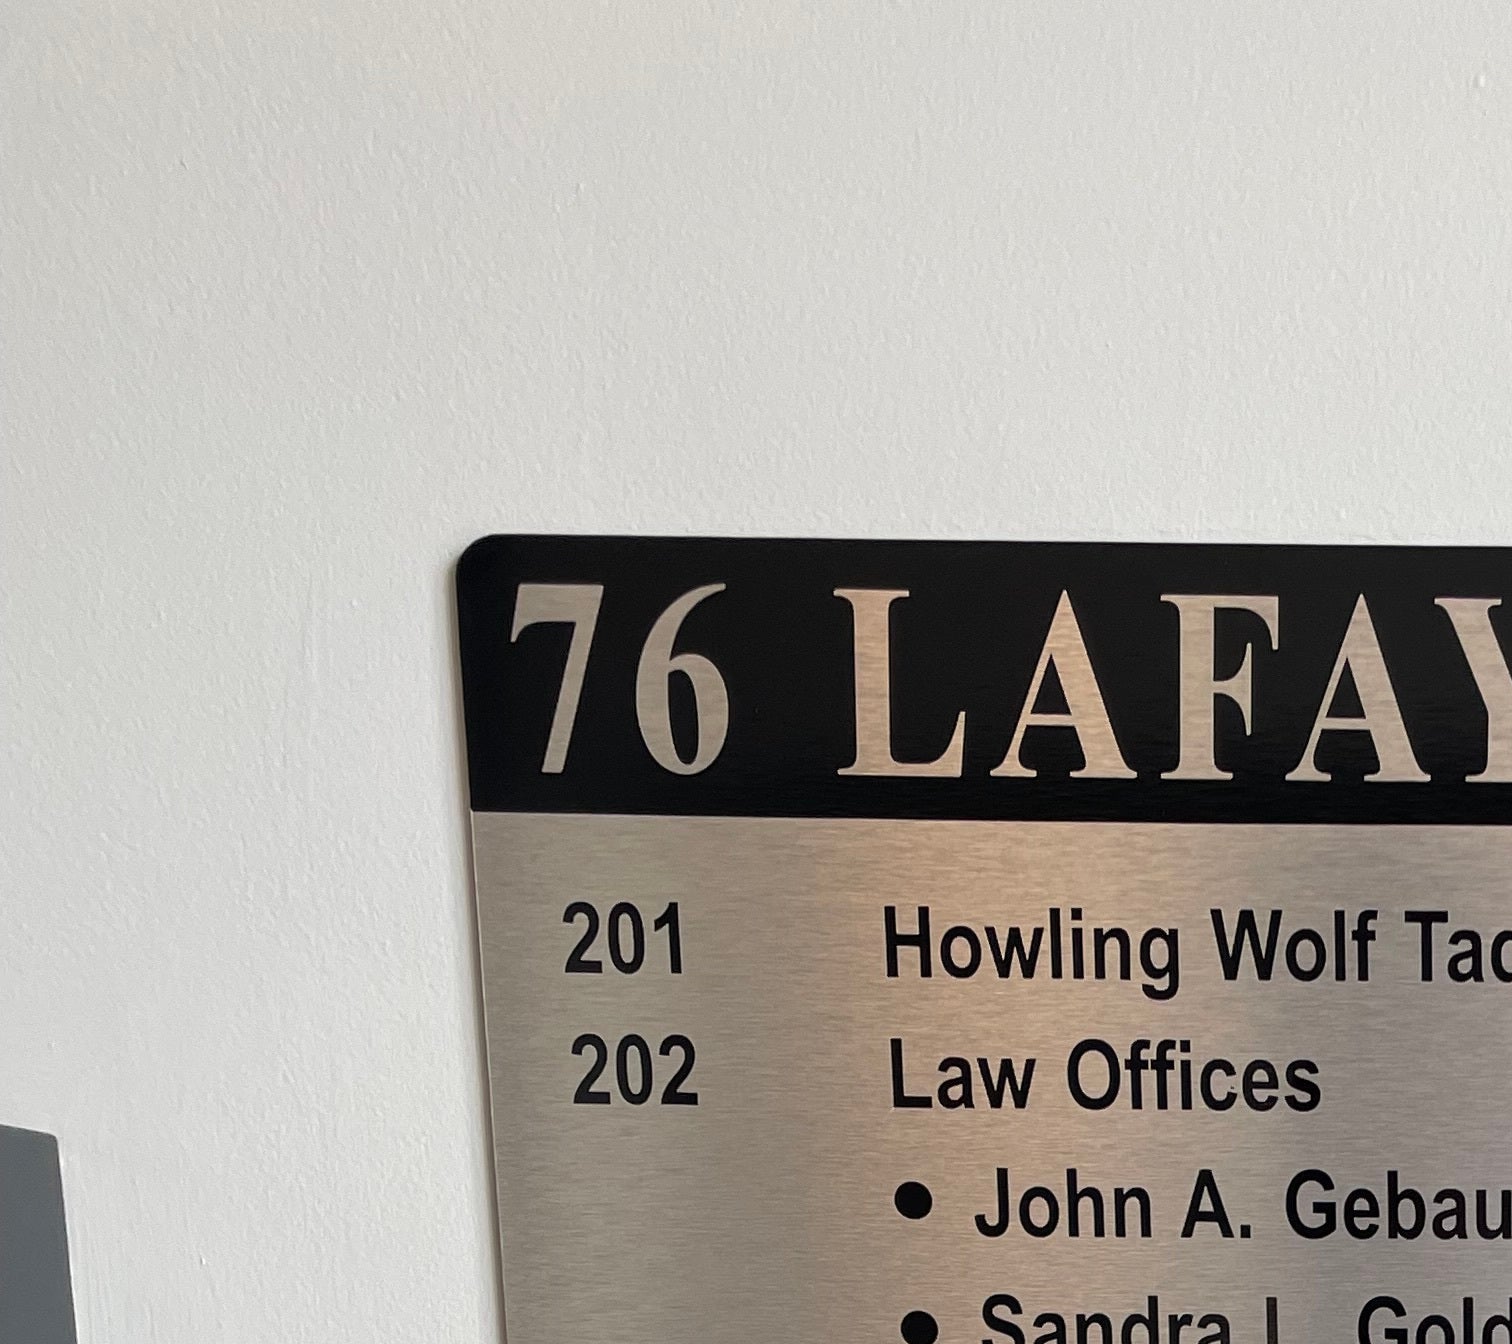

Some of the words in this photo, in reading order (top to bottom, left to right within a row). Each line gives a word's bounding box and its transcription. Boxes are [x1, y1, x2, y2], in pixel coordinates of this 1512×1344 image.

[510, 582, 729, 776] 76
[562, 901, 683, 975] 201
[883, 905, 1180, 1001] Howling
[1209, 908, 1379, 983] Wolf
[571, 1033, 699, 1106] 202
[889, 1037, 1037, 1110] Law
[1066, 1038, 1321, 1113] Offices
[974, 1167, 1153, 1238] John
[1180, 1168, 1252, 1239] A.
